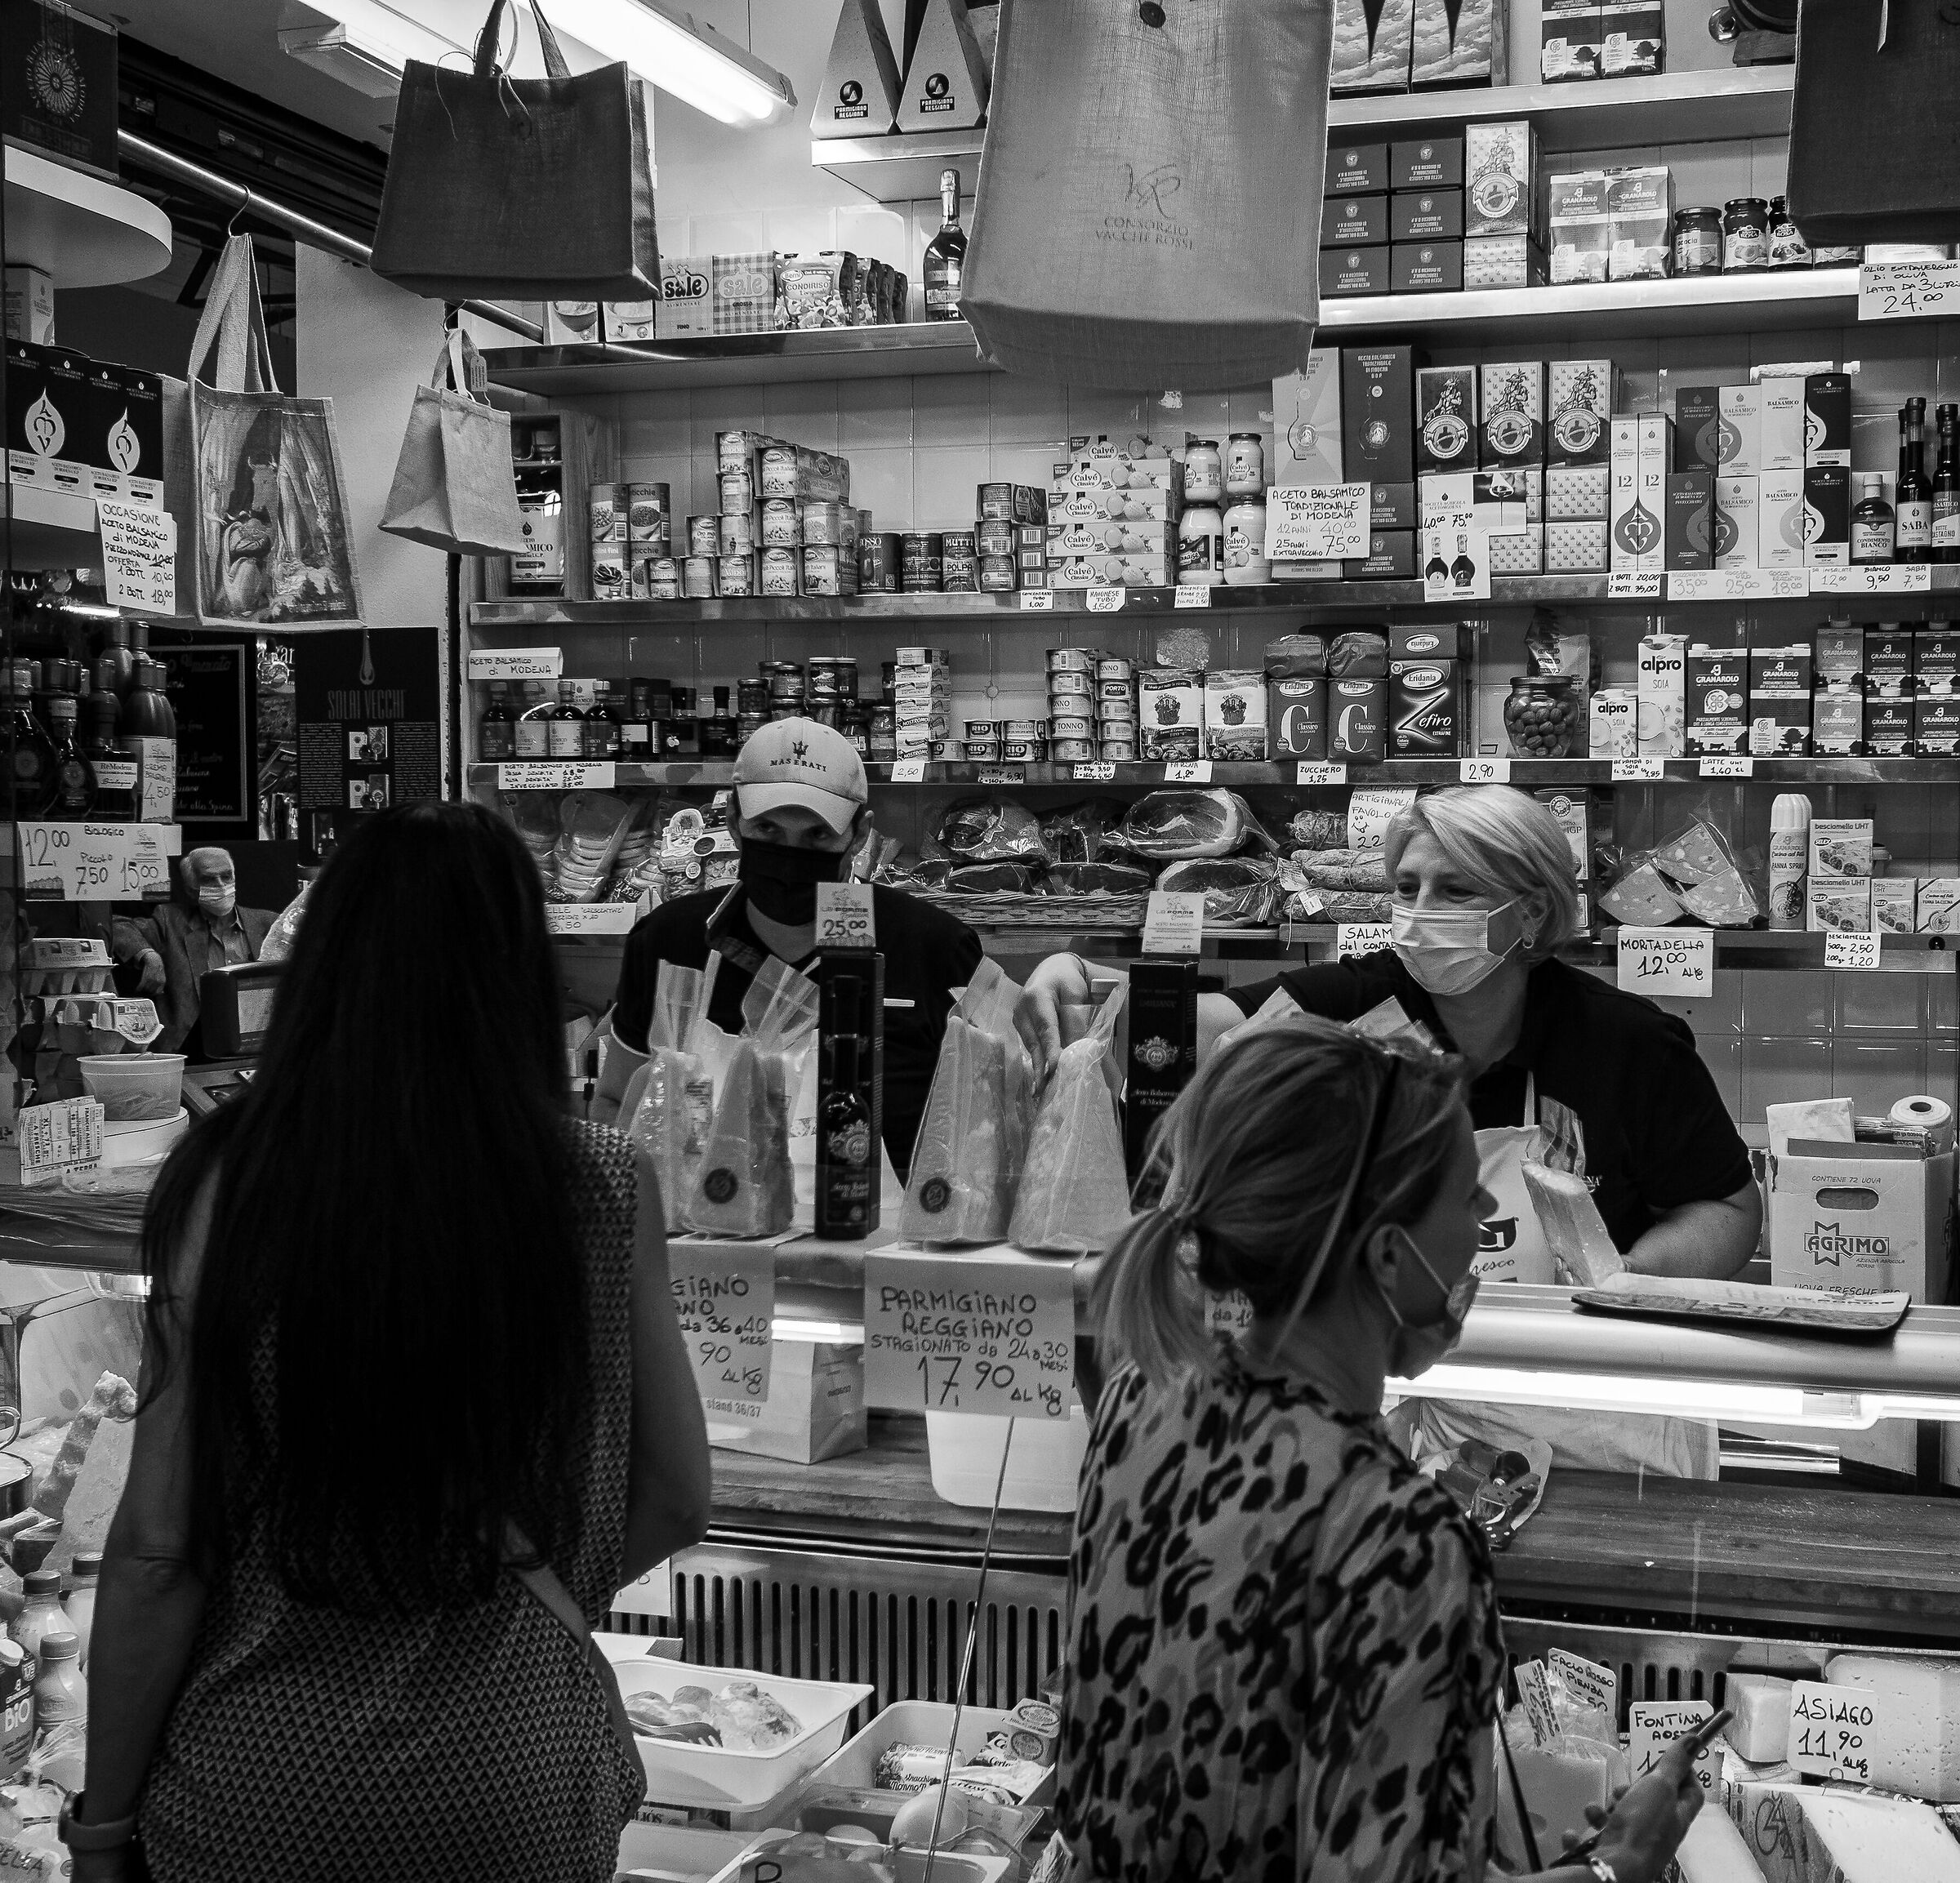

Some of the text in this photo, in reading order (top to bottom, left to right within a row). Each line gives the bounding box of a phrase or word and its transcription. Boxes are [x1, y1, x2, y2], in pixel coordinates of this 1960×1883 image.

[664, 276, 702, 299] sale
[724, 276, 764, 296] sale
[786, 282, 830, 292] CONDIRISO
[1091, 445, 1115, 455] Calvé
[1074, 472, 1098, 482] Calvé
[1616, 474, 1633, 487] 12
[1643, 474, 1659, 487] 12
[1272, 490, 1307, 501] ACETO
[1068, 501, 1093, 512] Calvé
[1901, 520, 1928, 531] SABA
[945, 537, 973, 547] MUTTI
[1067, 532, 1092, 545] Calvé
[1226, 536, 1246, 545] Calvé
[947, 563, 973, 572] POLPA
[1067, 565, 1092, 576] Calvé
[510, 665, 552, 674] MODENA
[1641, 657, 1682, 674] alpro
[1409, 672, 1437, 683] Eridania
[1695, 675, 1740, 684] GRANAROLO
[1762, 670, 1799, 679] GRANAROLO
[1652, 679, 1669, 689] SOIA
[1597, 703, 1628, 715] alpro
[1612, 718, 1626, 727] SOIA
[1871, 718, 1908, 726] GRANAROLO
[1922, 715, 1960, 723] GRANAROLO
[971, 724, 989, 733] RIO
[1297, 722, 1318, 732] Classico
[1354, 722, 1376, 732] Classico
[769, 758, 828, 772] MASERATI
[1468, 764, 1494, 781] 2,90
[1710, 767, 1731, 775] 1,40
[1308, 774, 1327, 784] 1,25
[1815, 822, 1854, 830] besciamella
[1828, 933, 1872, 942] BESCIAMELLA
[1339, 940, 1358, 951] del
[1620, 938, 1705, 952] MORTADELLA
[1849, 942, 1875, 955] 2,50
[1811, 1175, 1847, 1183] CONTIENE
[1807, 1236, 1886, 1257] AGRIMO
[1469, 1258, 1516, 1275] resco
[880, 1285, 1036, 1315] PARMIGIANO
[902, 1311, 1033, 1339] REGGIANO
[871, 1333, 971, 1354] STAGIONATO
[706, 1397, 733, 1413] stand
[1793, 1694, 1874, 1726] ASIAGO
[1634, 1710, 1704, 1729] FONTINA
